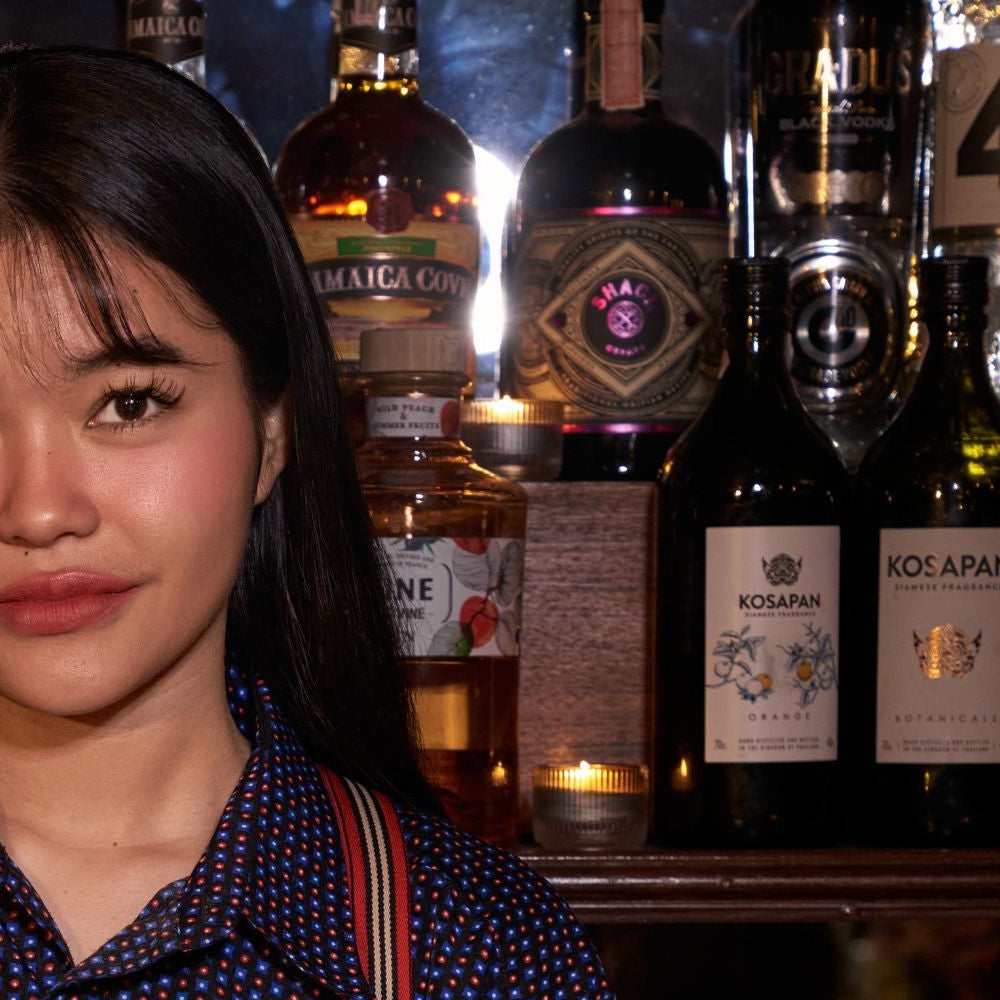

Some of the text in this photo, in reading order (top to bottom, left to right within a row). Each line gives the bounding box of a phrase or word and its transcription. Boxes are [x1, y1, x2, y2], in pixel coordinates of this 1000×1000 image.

[763, 47, 911, 96] GRADUS
[402, 404, 435, 413] PEACH
[739, 593, 821, 610] KOSAPAN
[748, 712, 811, 722] ORANGE
[895, 713, 997, 723] BOTANICALS
